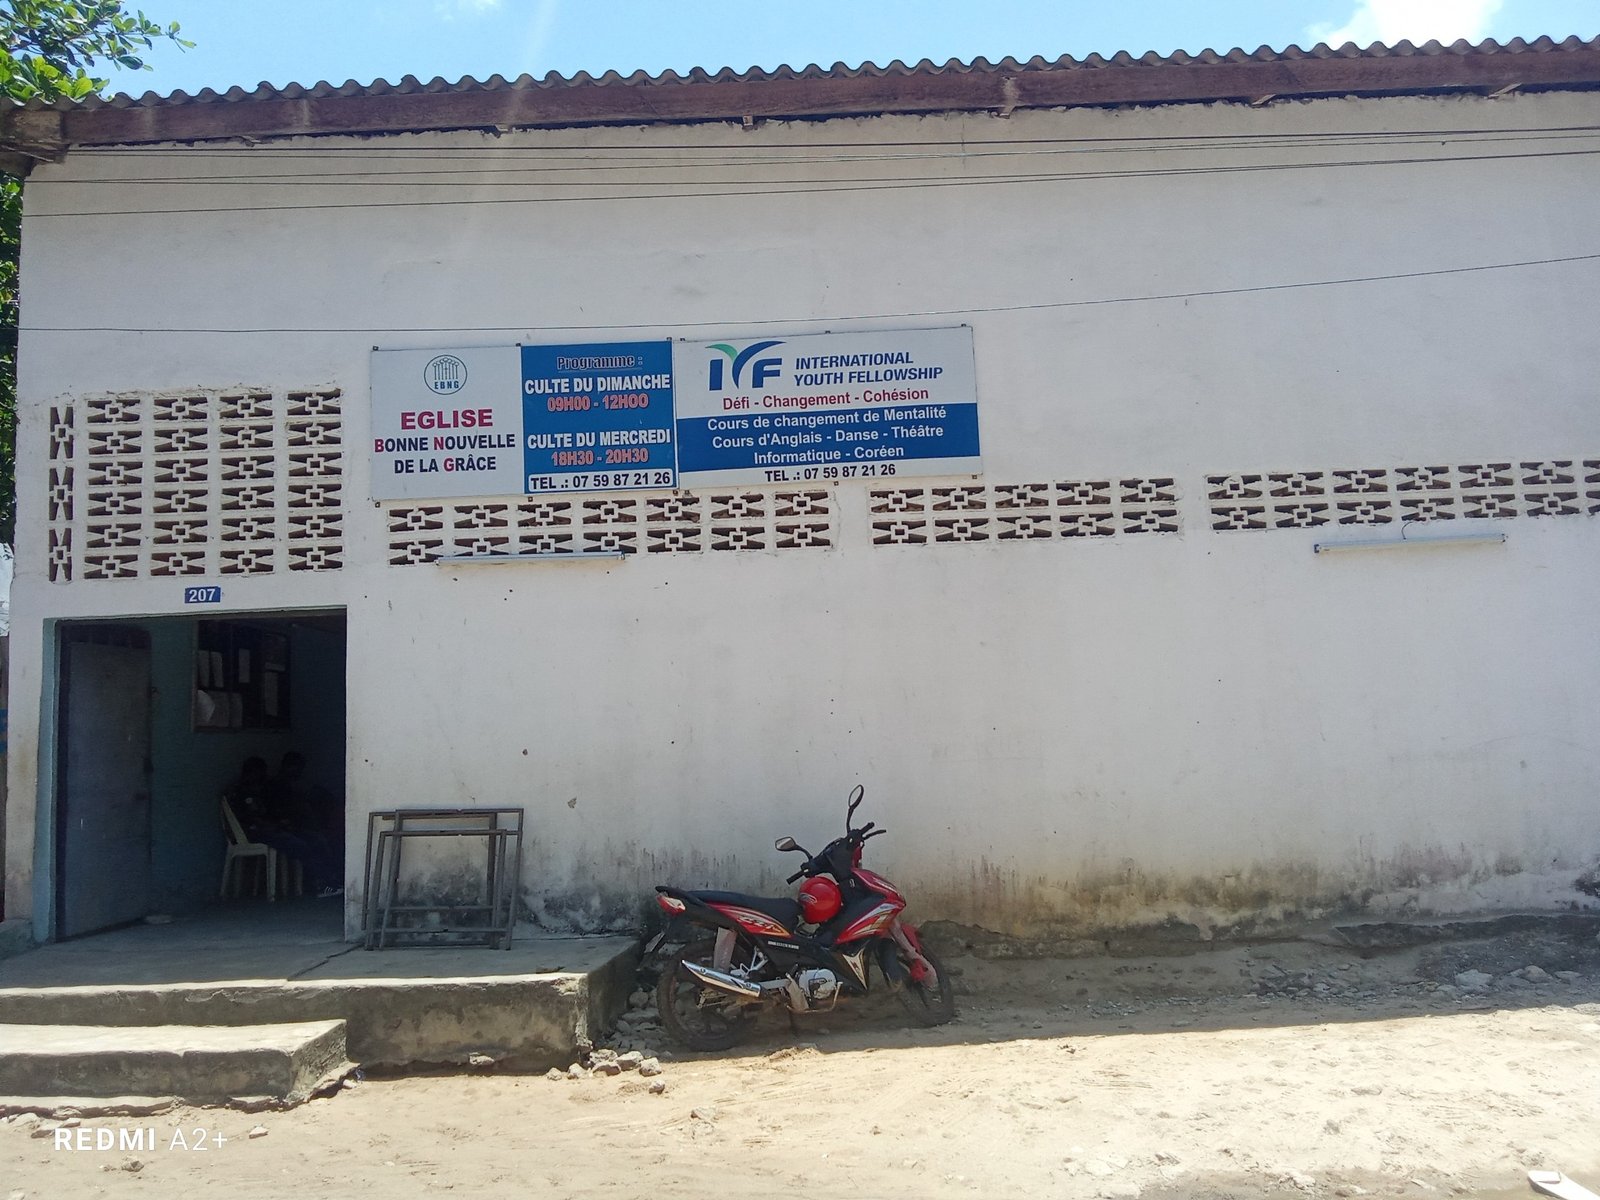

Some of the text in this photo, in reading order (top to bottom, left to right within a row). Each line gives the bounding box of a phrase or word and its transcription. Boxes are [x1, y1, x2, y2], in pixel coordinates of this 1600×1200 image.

[556, 355, 635, 371] Programme
[795, 351, 914, 370] INTERNATIONAL
[434, 380, 460, 390] EBNG
[525, 374, 670, 395] CULTE DU DIMANCHE
[794, 367, 943, 386] YOUTH FELLOWSHIP
[547, 396, 591, 412] 09H00
[723, 396, 750, 410] Défi
[763, 392, 850, 409] Changement
[863, 388, 929, 403] Cohésion
[401, 409, 493, 430] EGLISE
[707, 406, 947, 431] Cours de changement de Mentalité
[374, 434, 516, 453] BONNE NOUVELLE
[527, 429, 671, 449] CULTE DU MERCREDI
[712, 436, 754, 448] Cours
[758, 431, 822, 447] d'Anglais
[835, 430, 879, 442] Danse
[891, 425, 944, 438] Théâtre
[394, 454, 496, 474] DE LA GRÂCE
[551, 450, 594, 467] 18H30
[605, 448, 648, 464] 20H30
[754, 449, 841, 464] Informatique
[854, 445, 904, 459] Coréen
[572, 475, 589, 488] 07
[593, 474, 609, 487] 59
[613, 473, 630, 486] 87
[634, 472, 649, 485] 21
[654, 472, 670, 484] 26
[804, 467, 819, 480] 07
[823, 467, 838, 478] 59
[842, 466, 857, 477] 87
[861, 465, 875, 476] 21
[880, 464, 896, 475] 26
[189, 588, 216, 602] 207
